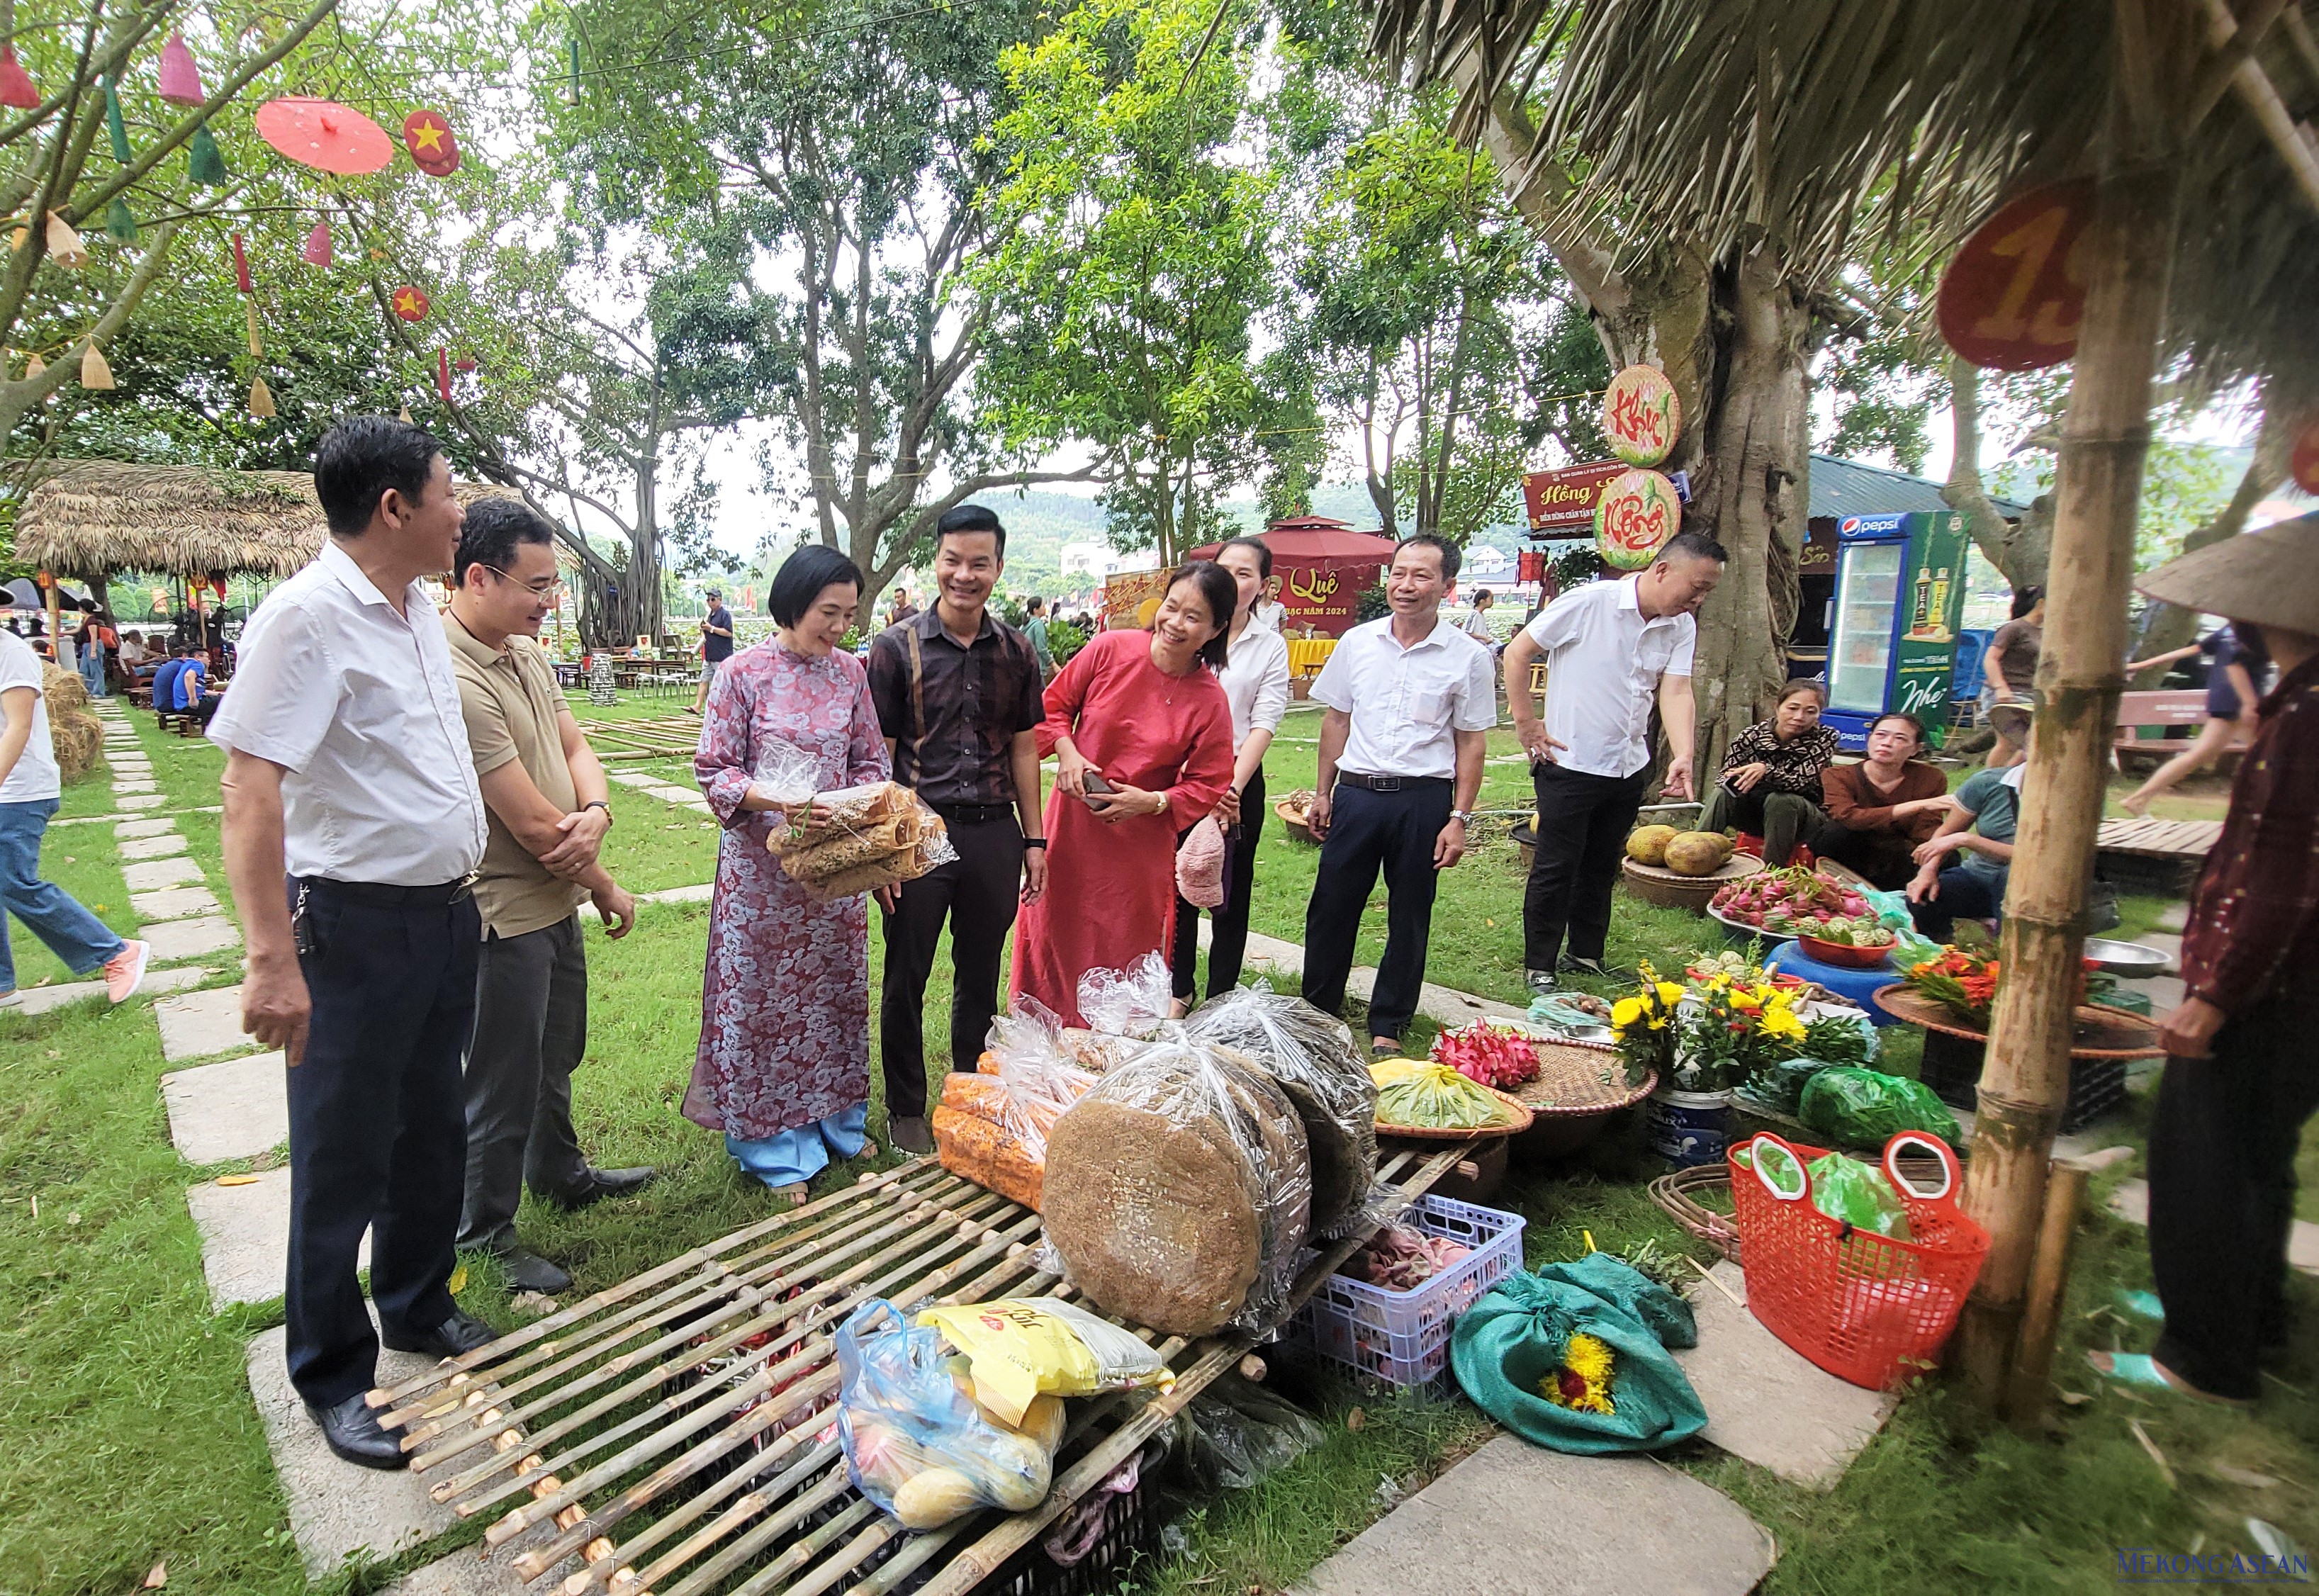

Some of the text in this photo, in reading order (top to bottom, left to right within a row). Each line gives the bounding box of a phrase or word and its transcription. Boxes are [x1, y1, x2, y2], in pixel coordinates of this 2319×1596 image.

[1540, 483, 1593, 505] Hồng
[1603, 495, 1663, 550] Nông
[1860, 518, 1899, 534] pepsi
[1290, 568, 1339, 604] Quê
[1303, 607, 1324, 615] NĂM
[1900, 676, 1948, 714] Nhẹ
[1841, 733, 1866, 741] pepsi
